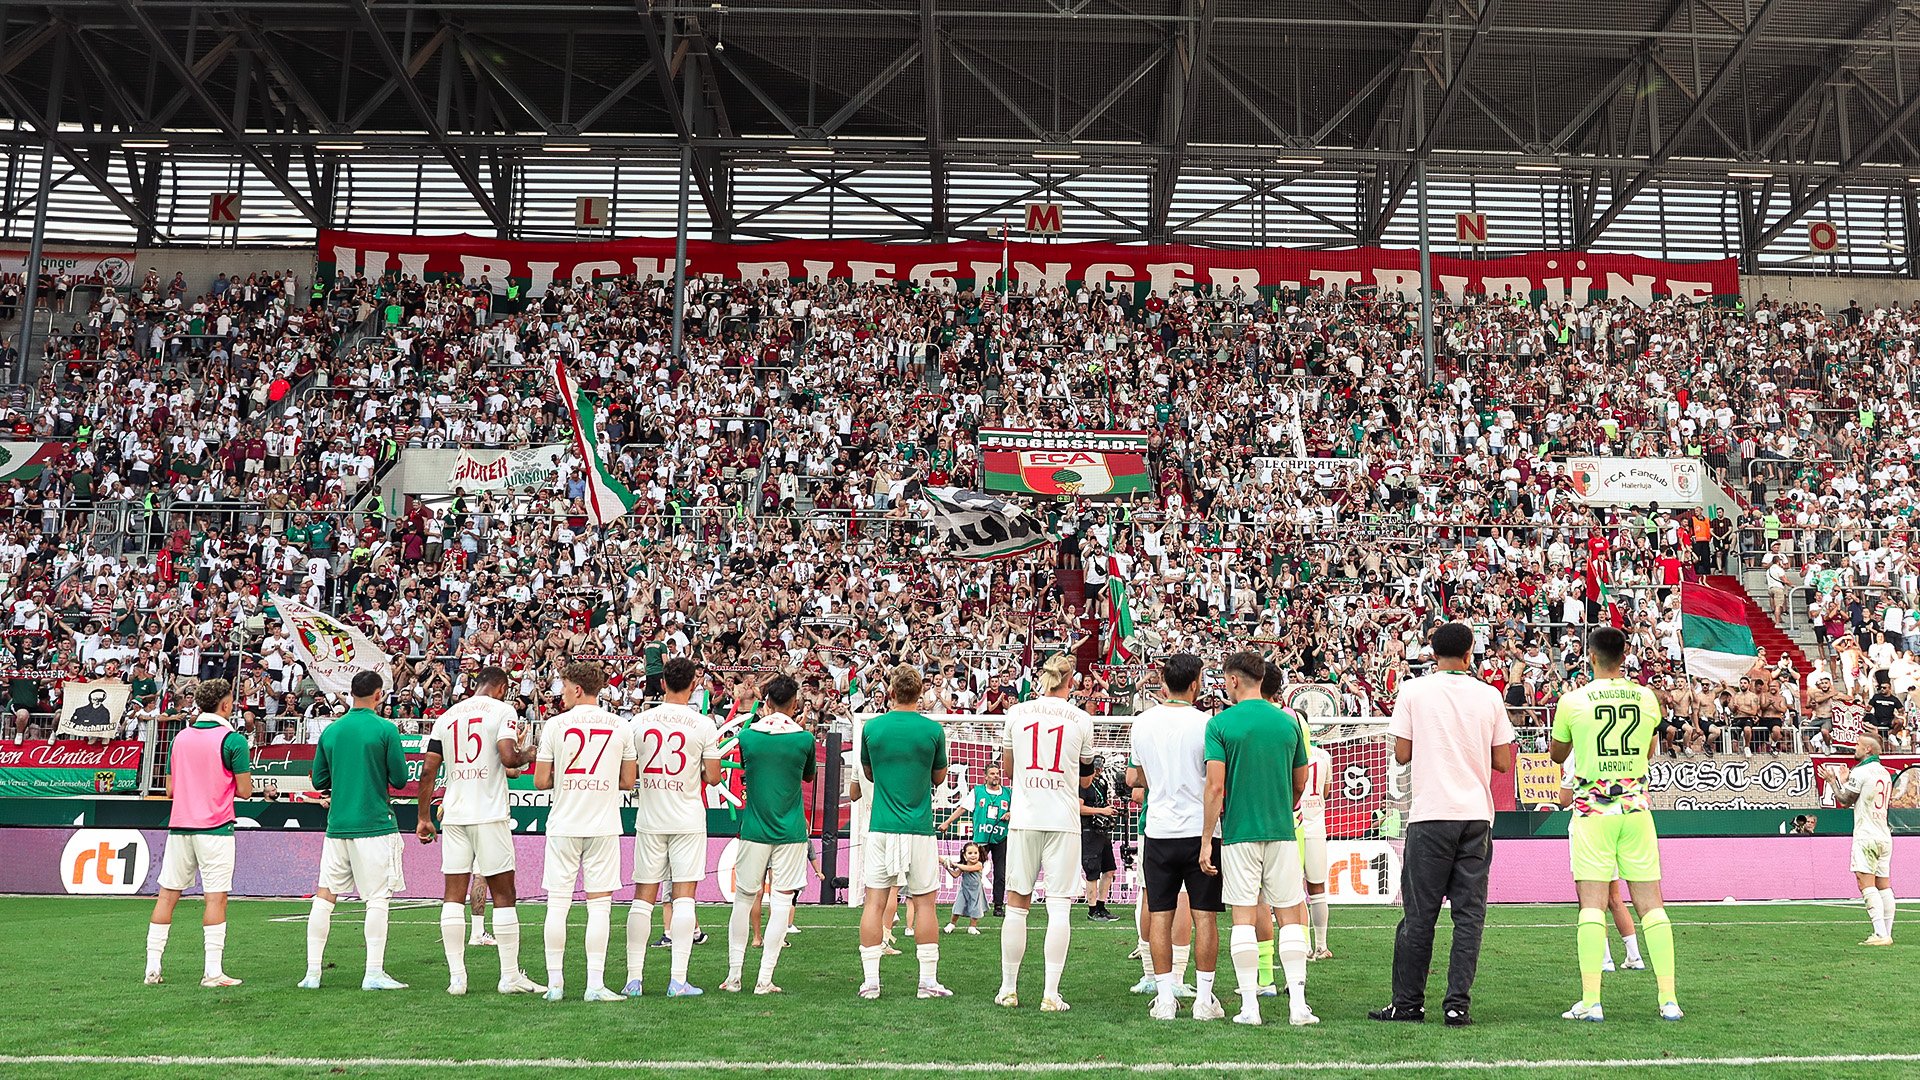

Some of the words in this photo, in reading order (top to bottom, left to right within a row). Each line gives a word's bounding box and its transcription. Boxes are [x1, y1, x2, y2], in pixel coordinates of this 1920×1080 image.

[212, 196, 238, 221] K
[583, 202, 601, 224] L
[1028, 205, 1061, 232] M
[1458, 216, 1485, 242] N
[987, 436, 1138, 450] FUGGERSTADT
[1029, 452, 1096, 465] FCA
[1574, 462, 1596, 471] FCA
[1673, 463, 1696, 473] FCA
[1603, 471, 1626, 488] FCA
[1630, 468, 1668, 488] Fanclub
[1599, 690, 1641, 701] AUGSBURG
[571, 714, 619, 729] AUGSBURG
[653, 714, 697, 729] AUGSBURG
[1594, 704, 1641, 757] 22
[447, 717, 483, 764] 15
[564, 727, 614, 775] 27
[1023, 721, 1065, 774] 11
[29, 744, 108, 765] United
[109, 746, 140, 766] 07
[643, 728, 687, 775] 23
[34, 779, 49, 787] Eine
[117, 780, 134, 788] 2007
[562, 779, 610, 791] ENGELS
[643, 778, 684, 793] BAUER
[979, 823, 1006, 836] HOST
[72, 842, 138, 885] rt1
[1328, 852, 1390, 895] rt1
